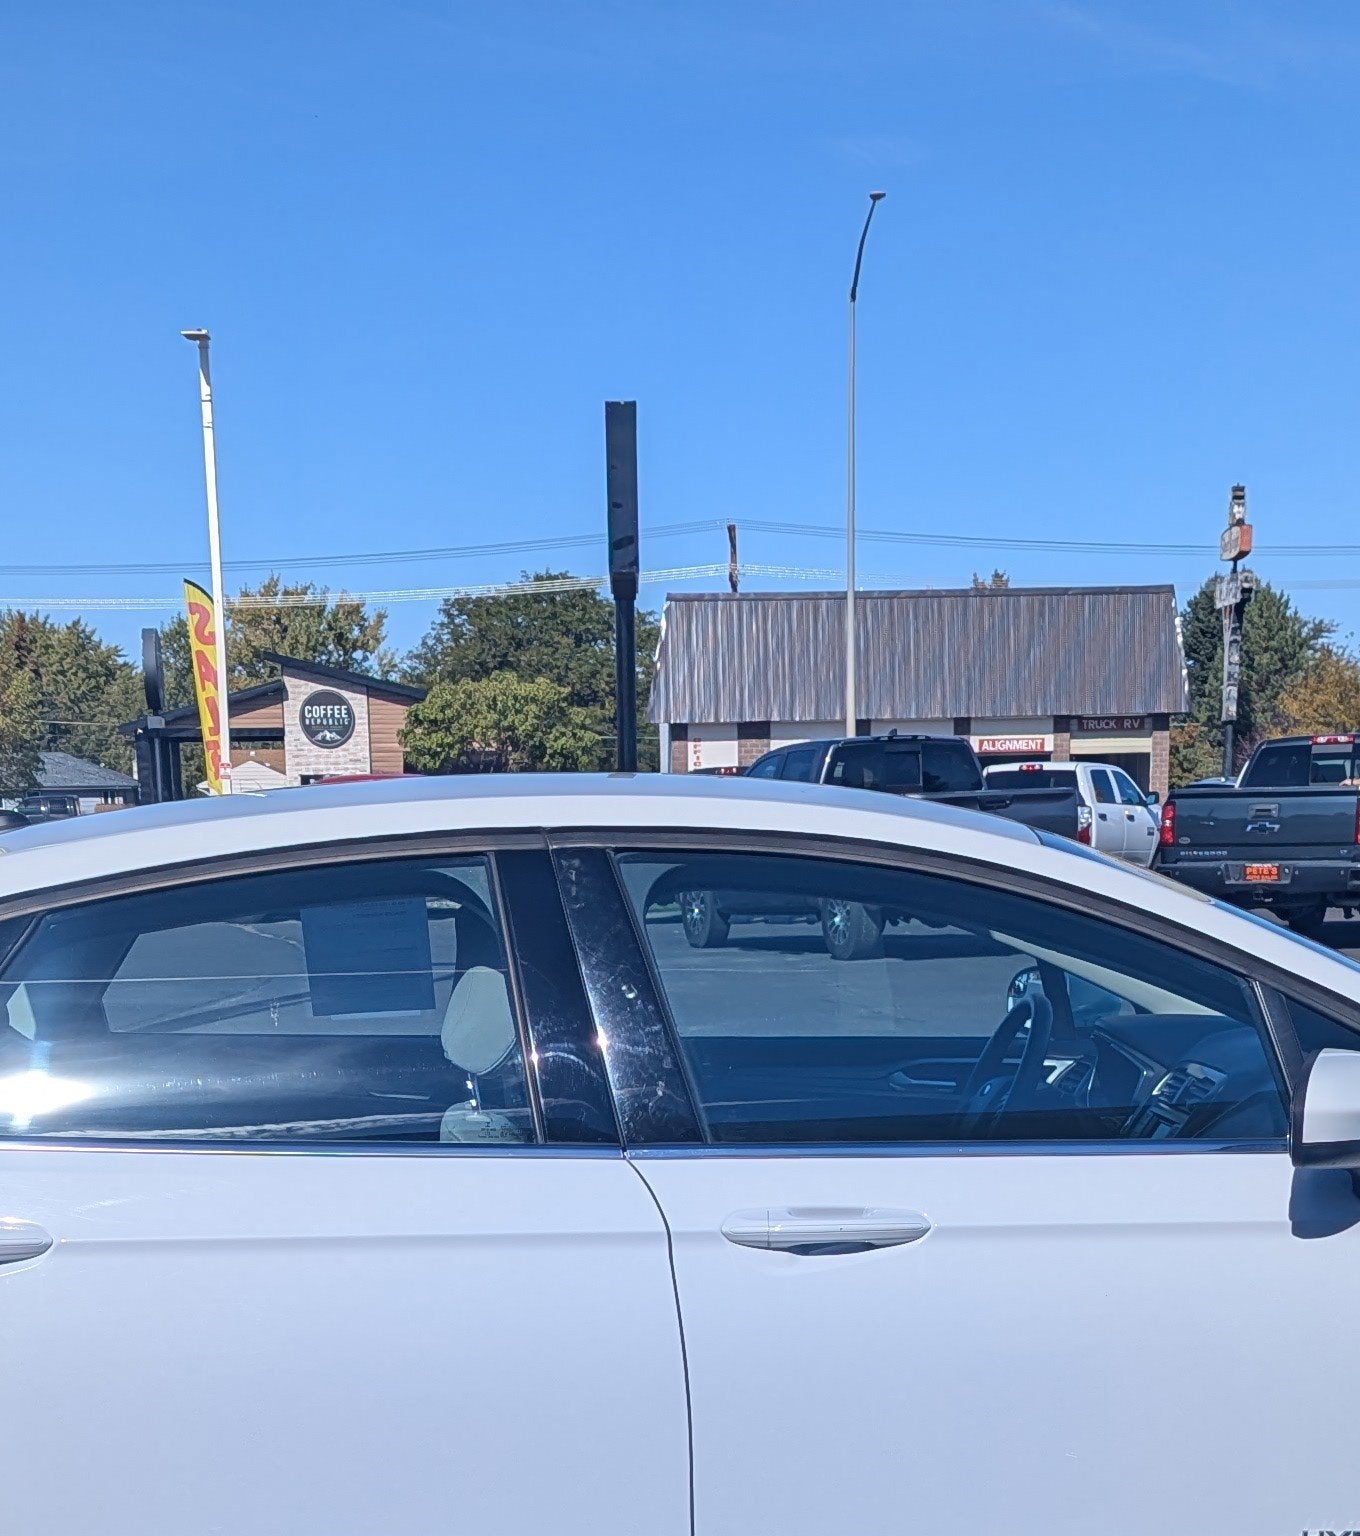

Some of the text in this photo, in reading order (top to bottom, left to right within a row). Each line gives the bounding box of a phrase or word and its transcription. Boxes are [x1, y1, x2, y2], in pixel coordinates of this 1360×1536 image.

[304, 705, 349, 718] COFFEE
[1082, 717, 1141, 730] TRUCK RV
[981, 739, 1043, 751] ALIGNMENT
[1246, 866, 1278, 875] PETE'S
